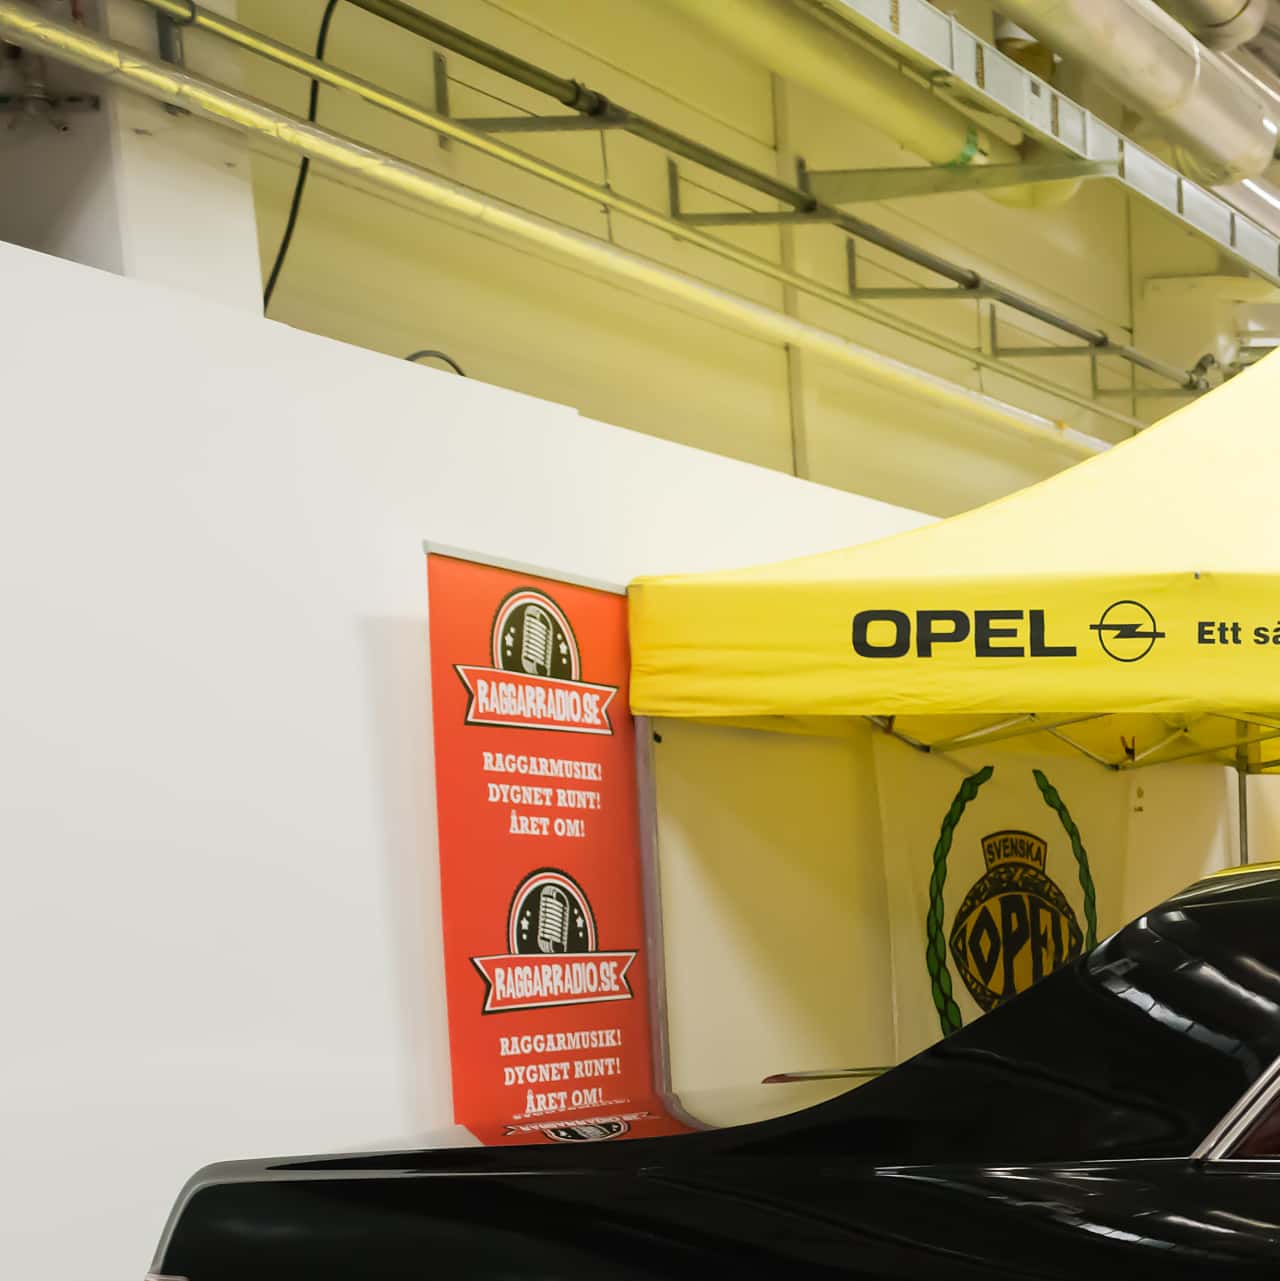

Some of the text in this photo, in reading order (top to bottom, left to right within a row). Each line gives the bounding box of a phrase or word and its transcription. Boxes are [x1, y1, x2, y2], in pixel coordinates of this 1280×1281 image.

[851, 609, 1077, 659] OPEL
[1197, 621, 1242, 645] Ett
[476, 679, 602, 726] RAGGARRADIO.SE
[483, 751, 602, 781] RAGGARMUSIK!
[488, 783, 601, 809] DYGNET RUNT!
[509, 808, 586, 837] ÅRET OM!
[986, 837, 1042, 866] SVENSKA
[494, 960, 620, 1001] RAGGARRADIO.SE
[499, 1028, 622, 1057] RAGGARMUSIK!
[503, 1057, 622, 1086] DYGNET RUNT!
[525, 1088, 567, 1114] ÅRET
[571, 1087, 603, 1107] OM!
